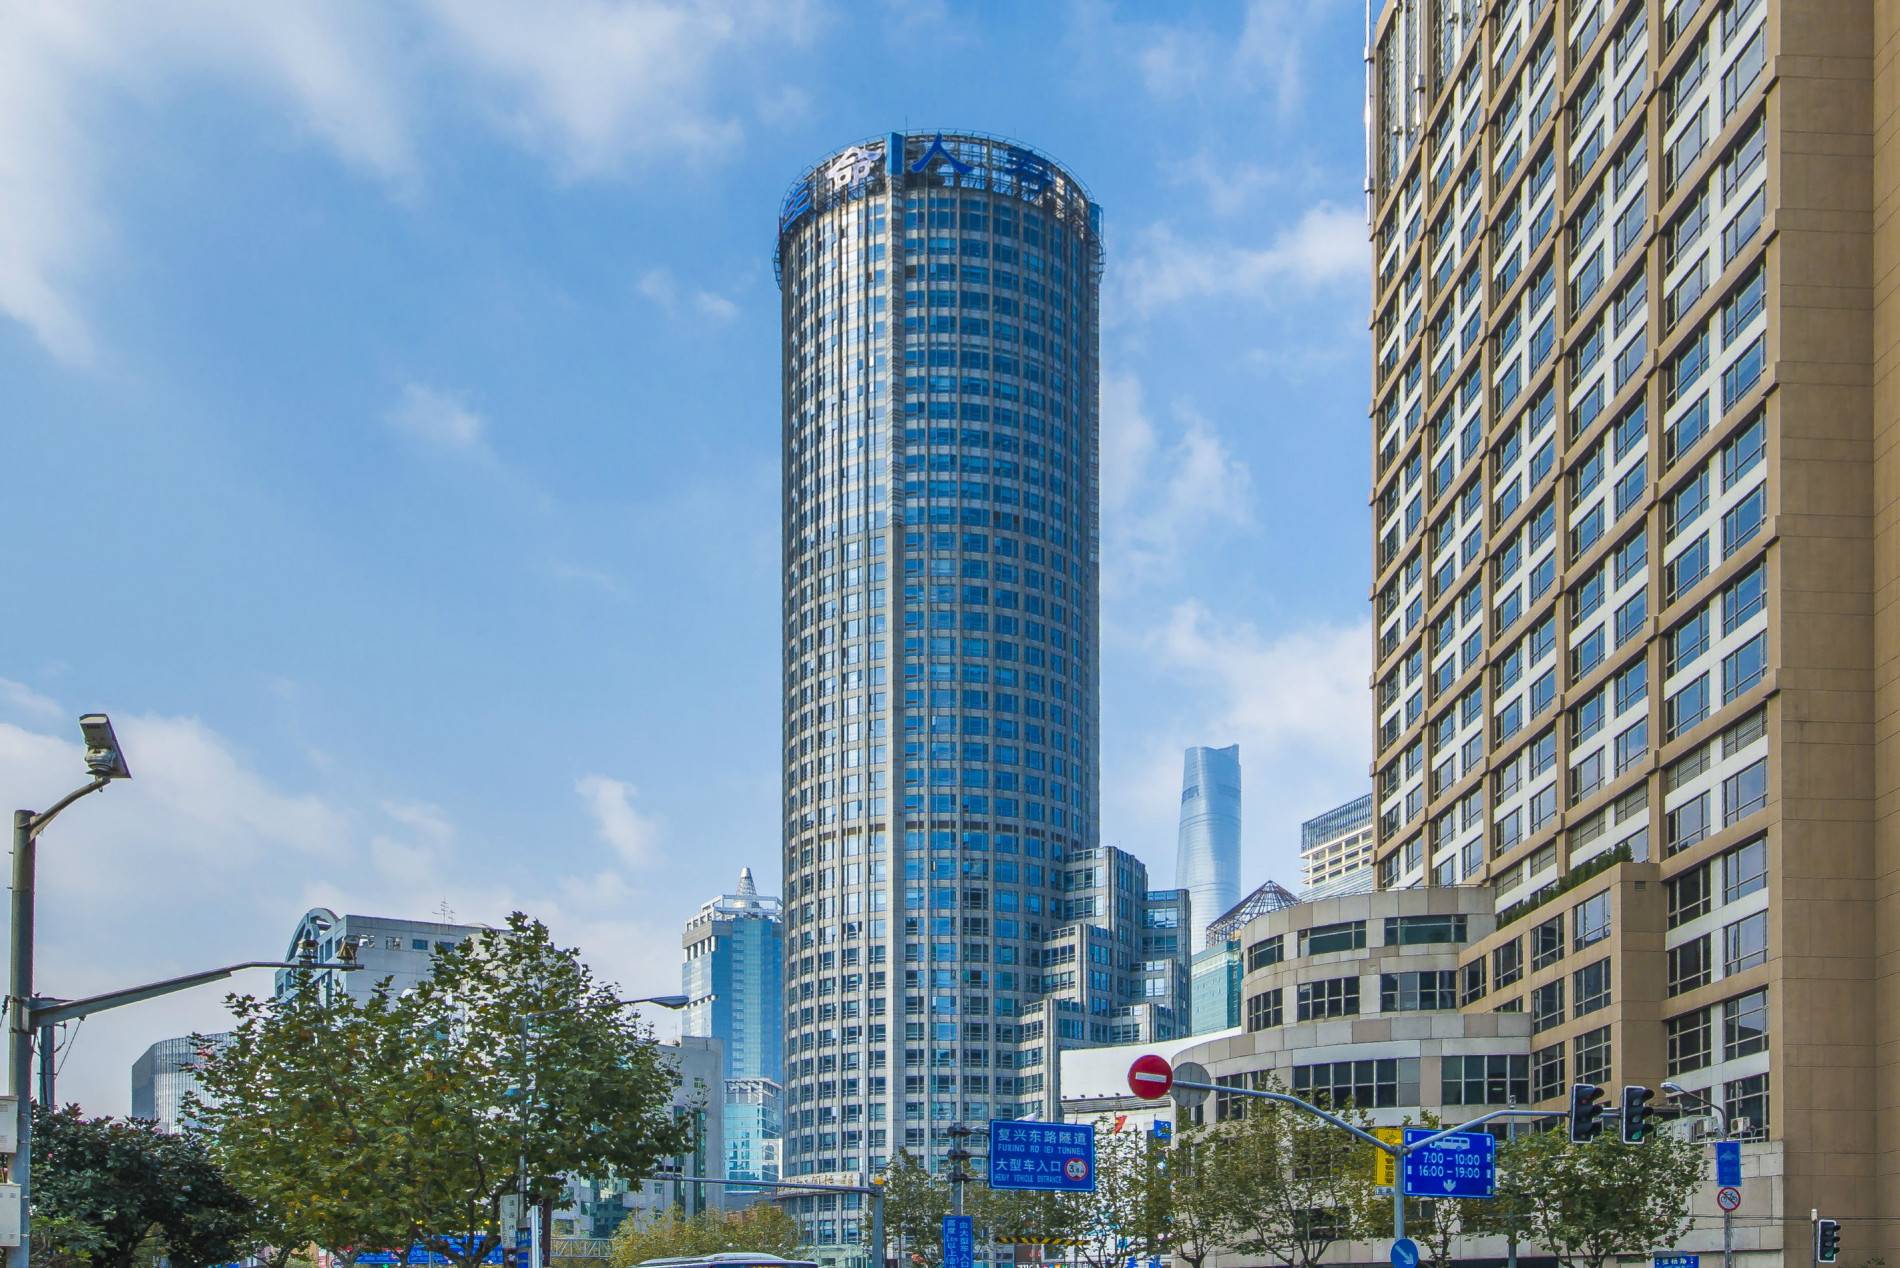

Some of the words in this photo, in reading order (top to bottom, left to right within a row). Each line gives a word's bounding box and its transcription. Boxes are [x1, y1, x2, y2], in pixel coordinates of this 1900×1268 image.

[997, 1128, 1087, 1145] 复兴东路隧道
[998, 1144, 1025, 1152] FUXING
[1058, 1146, 1085, 1156] TUNNEL
[996, 1158, 1060, 1172] 大型车入口
